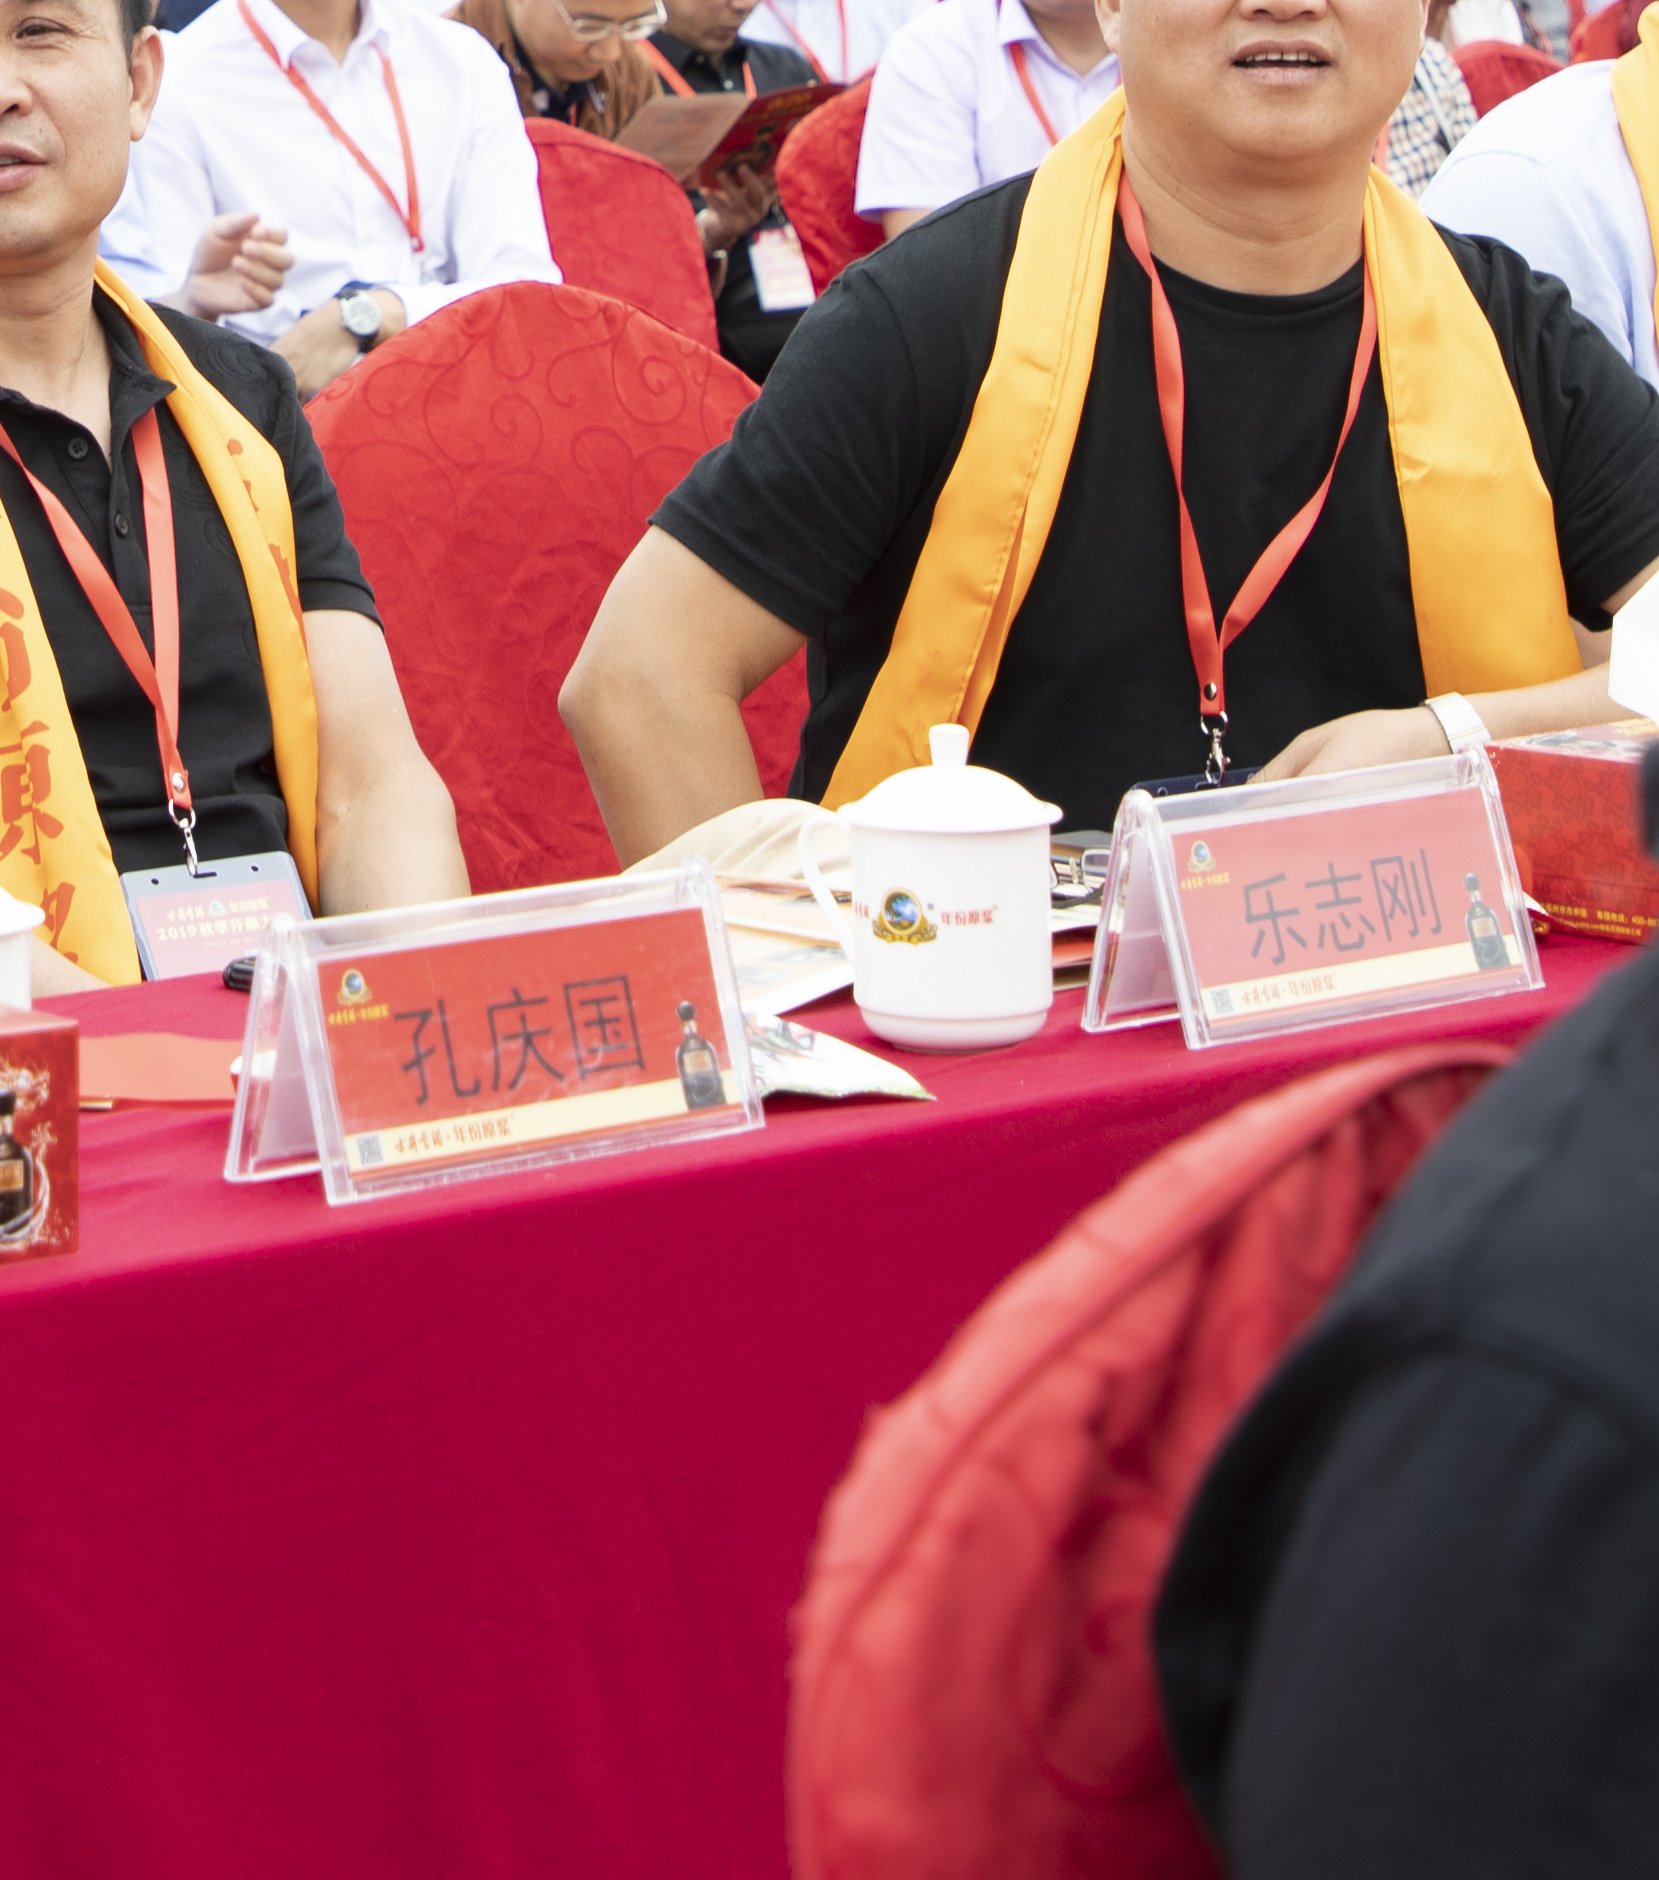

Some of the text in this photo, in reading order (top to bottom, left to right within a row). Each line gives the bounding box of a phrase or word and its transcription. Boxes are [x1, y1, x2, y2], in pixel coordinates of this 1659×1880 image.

[1243, 848, 1443, 966] 乐志刚
[393, 974, 648, 1106] 孔庆国
